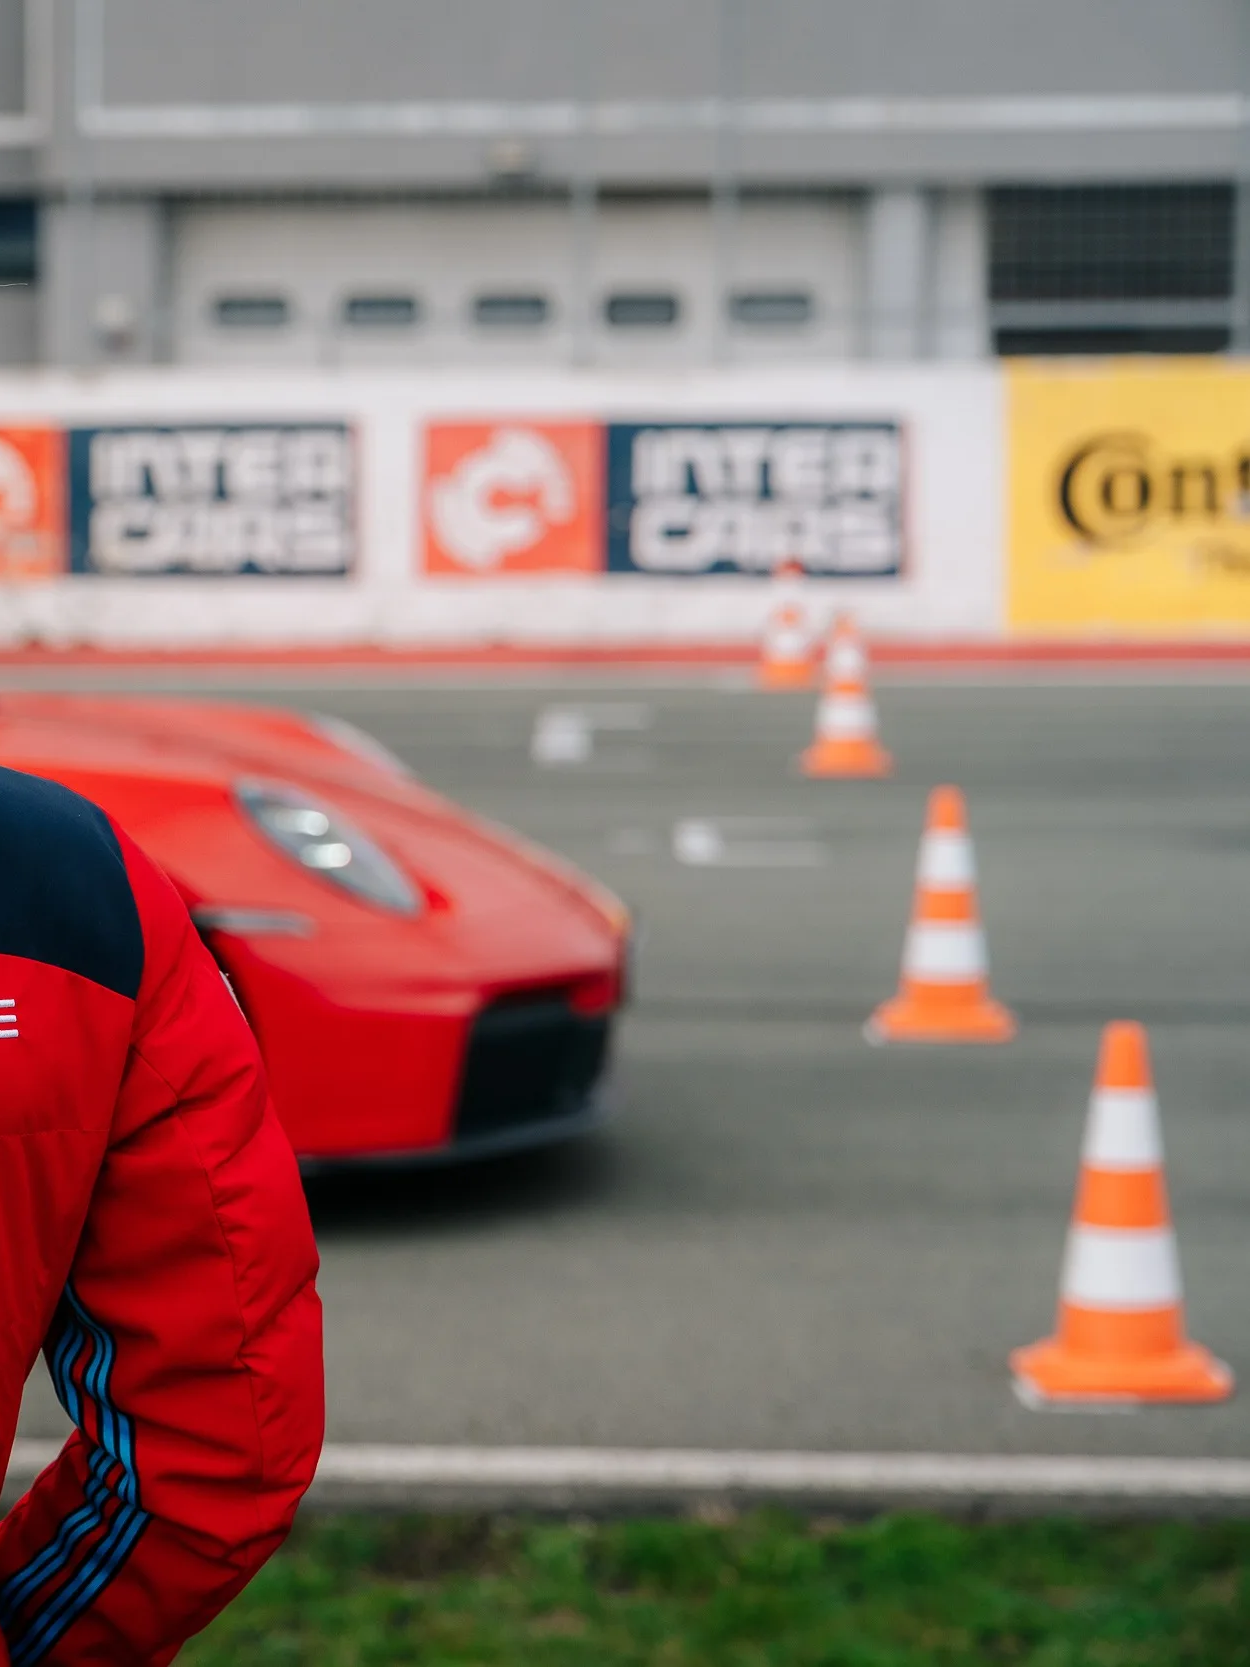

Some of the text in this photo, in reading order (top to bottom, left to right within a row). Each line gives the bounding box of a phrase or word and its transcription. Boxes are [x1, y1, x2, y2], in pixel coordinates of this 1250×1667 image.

[88, 429, 348, 500] INTER
[630, 428, 897, 499] INTER
[88, 502, 348, 572] CARS
[629, 502, 897, 572] CARS
